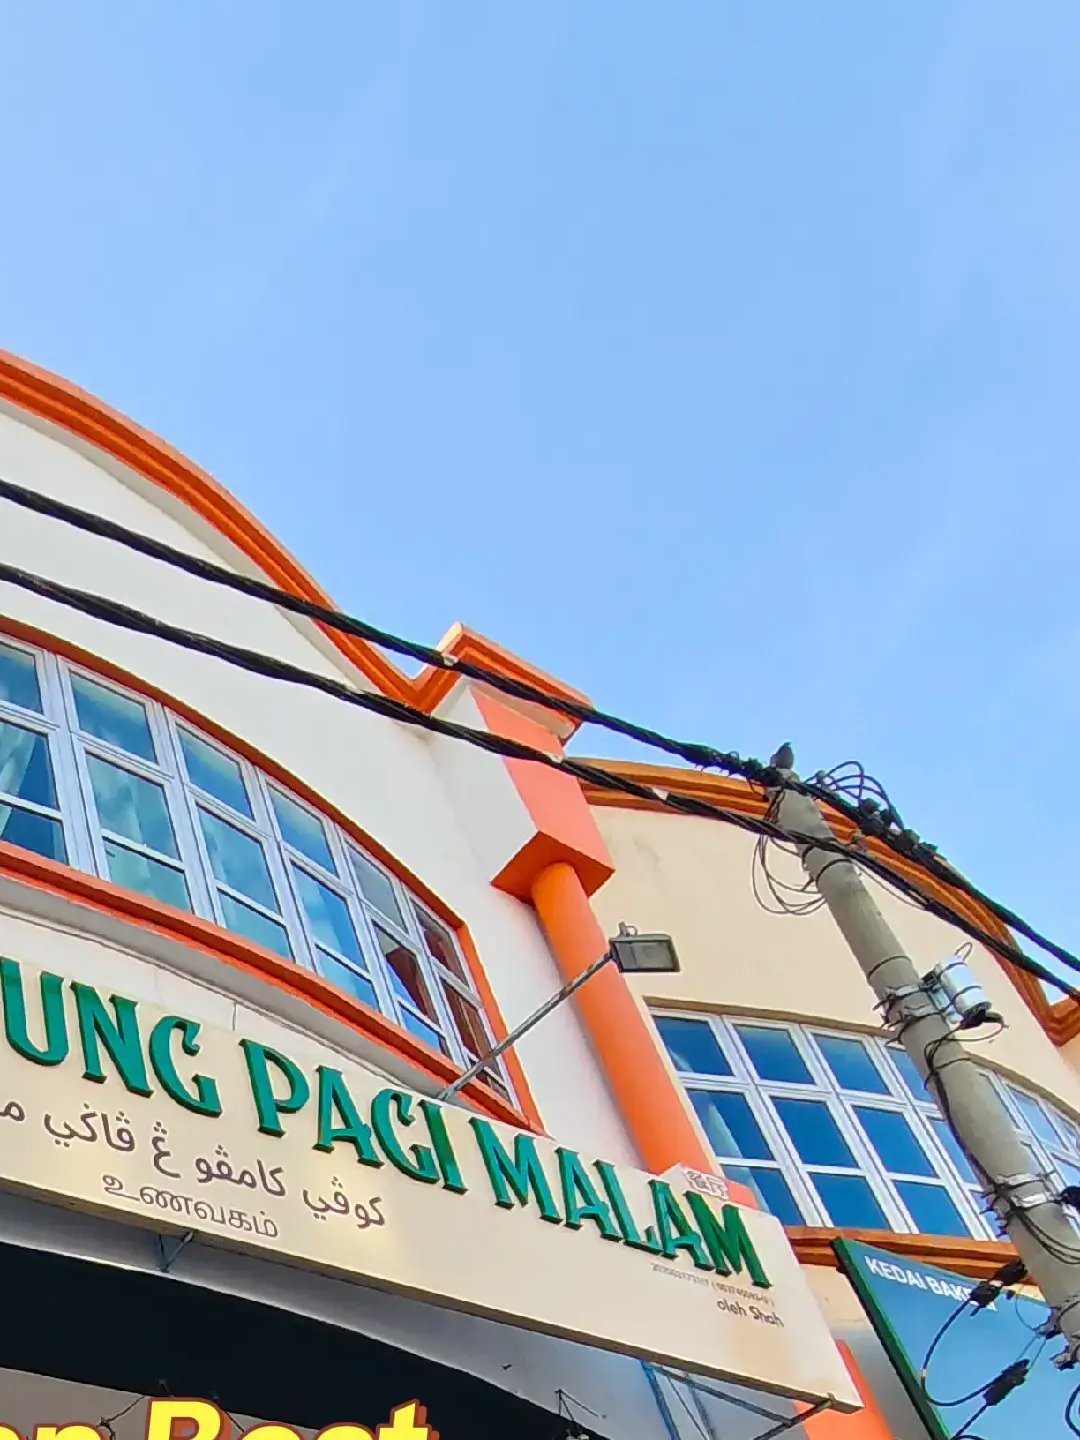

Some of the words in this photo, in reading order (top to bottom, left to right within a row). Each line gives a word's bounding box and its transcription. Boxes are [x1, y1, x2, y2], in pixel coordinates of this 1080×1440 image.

[239, 1038, 468, 1195] PAGI
[469, 1116, 773, 1289] MALAM
[101, 1173, 279, 1239] உணவகம்
[864, 1255, 927, 1290] KEDAI
[716, 1298, 748, 1317] oleh
